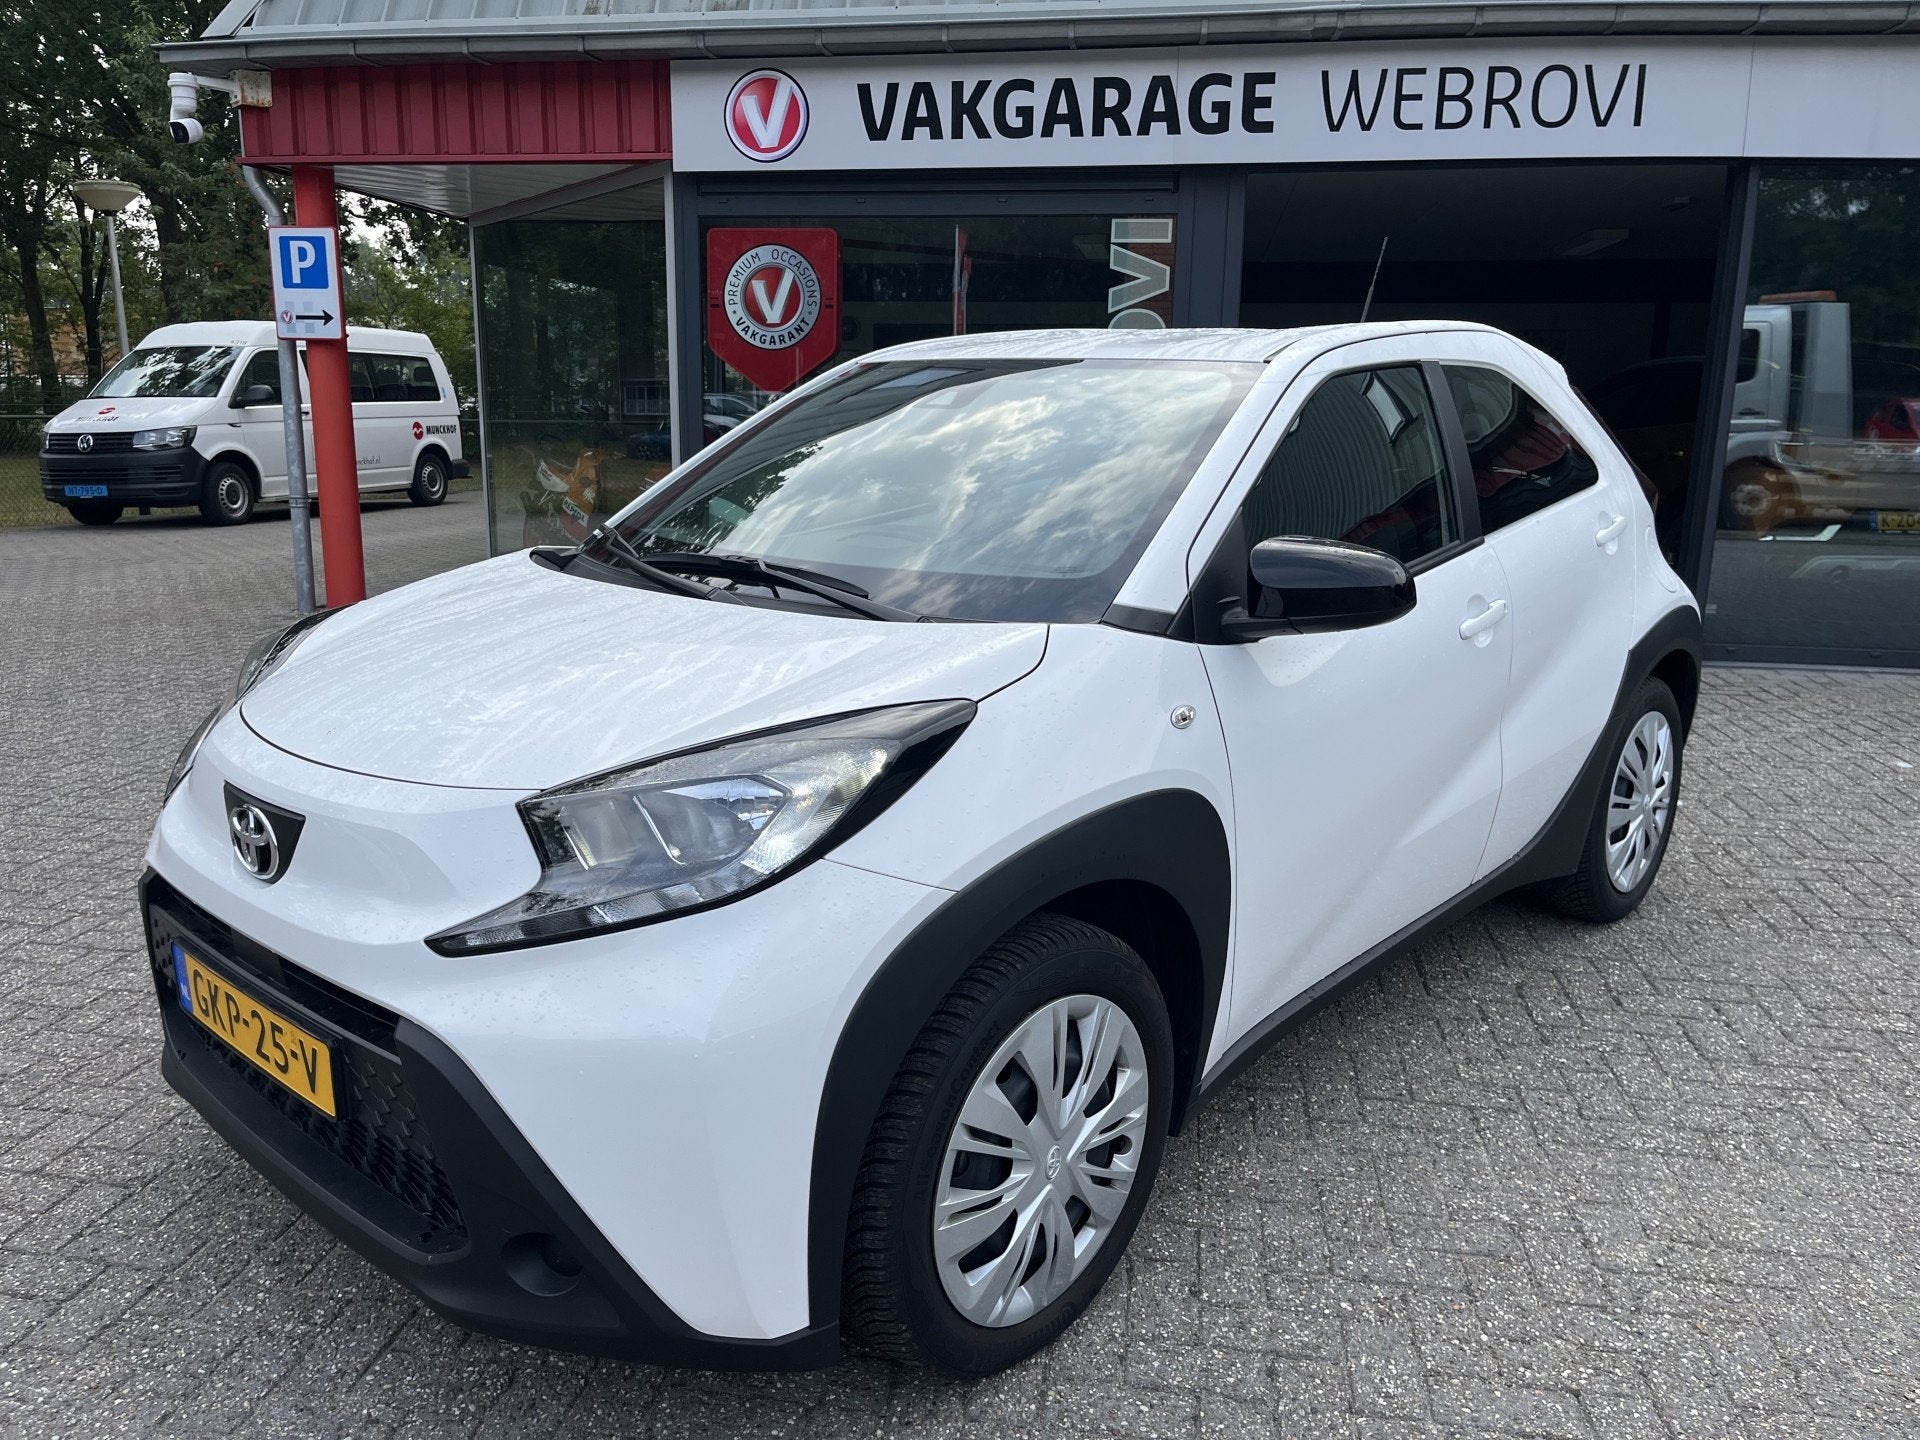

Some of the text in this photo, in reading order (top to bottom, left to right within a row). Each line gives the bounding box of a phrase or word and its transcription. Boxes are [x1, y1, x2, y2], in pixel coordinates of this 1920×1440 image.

[740, 75, 796, 148] V
[857, 64, 1647, 142] VAKGARAGE WEBROVI
[289, 240, 316, 284] P
[728, 249, 818, 308] PREMIUM OCCASIONS
[751, 267, 796, 324] V
[735, 317, 810, 346] VAKGARANT
[426, 424, 457, 435] MUNCKHOF
[357, 456, 381, 465] nckhof.nl
[181, 982, 191, 1001] NL
[193, 969, 318, 1094] GKP-25-V
